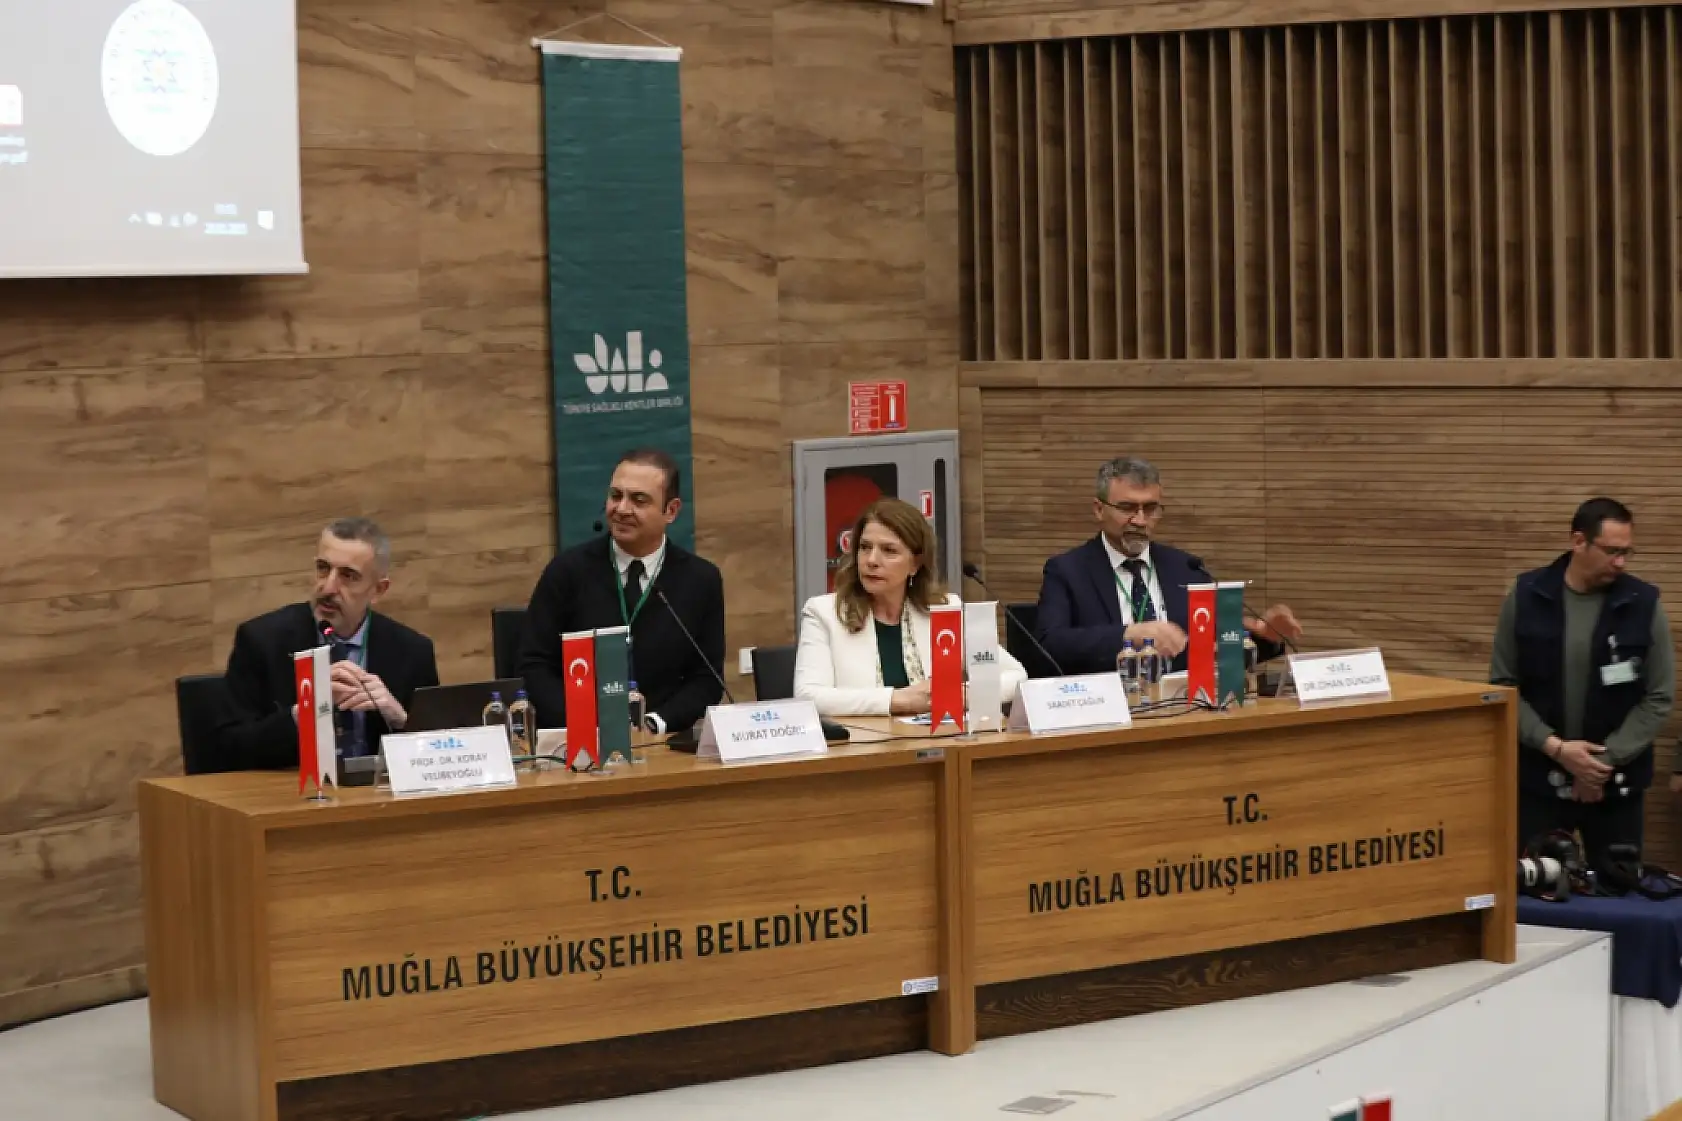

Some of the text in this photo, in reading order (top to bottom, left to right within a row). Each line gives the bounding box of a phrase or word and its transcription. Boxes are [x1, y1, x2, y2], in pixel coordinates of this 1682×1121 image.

[1222, 793, 1268, 825] T.C.
[584, 865, 641, 902] T.C.
[1029, 820, 1444, 913] MUĞLA BÜYÜKŞEHİR BELEDİYESİ
[342, 895, 869, 1000] MUĞLA BÜYÜKŞEHİR BELEDİYESİ
